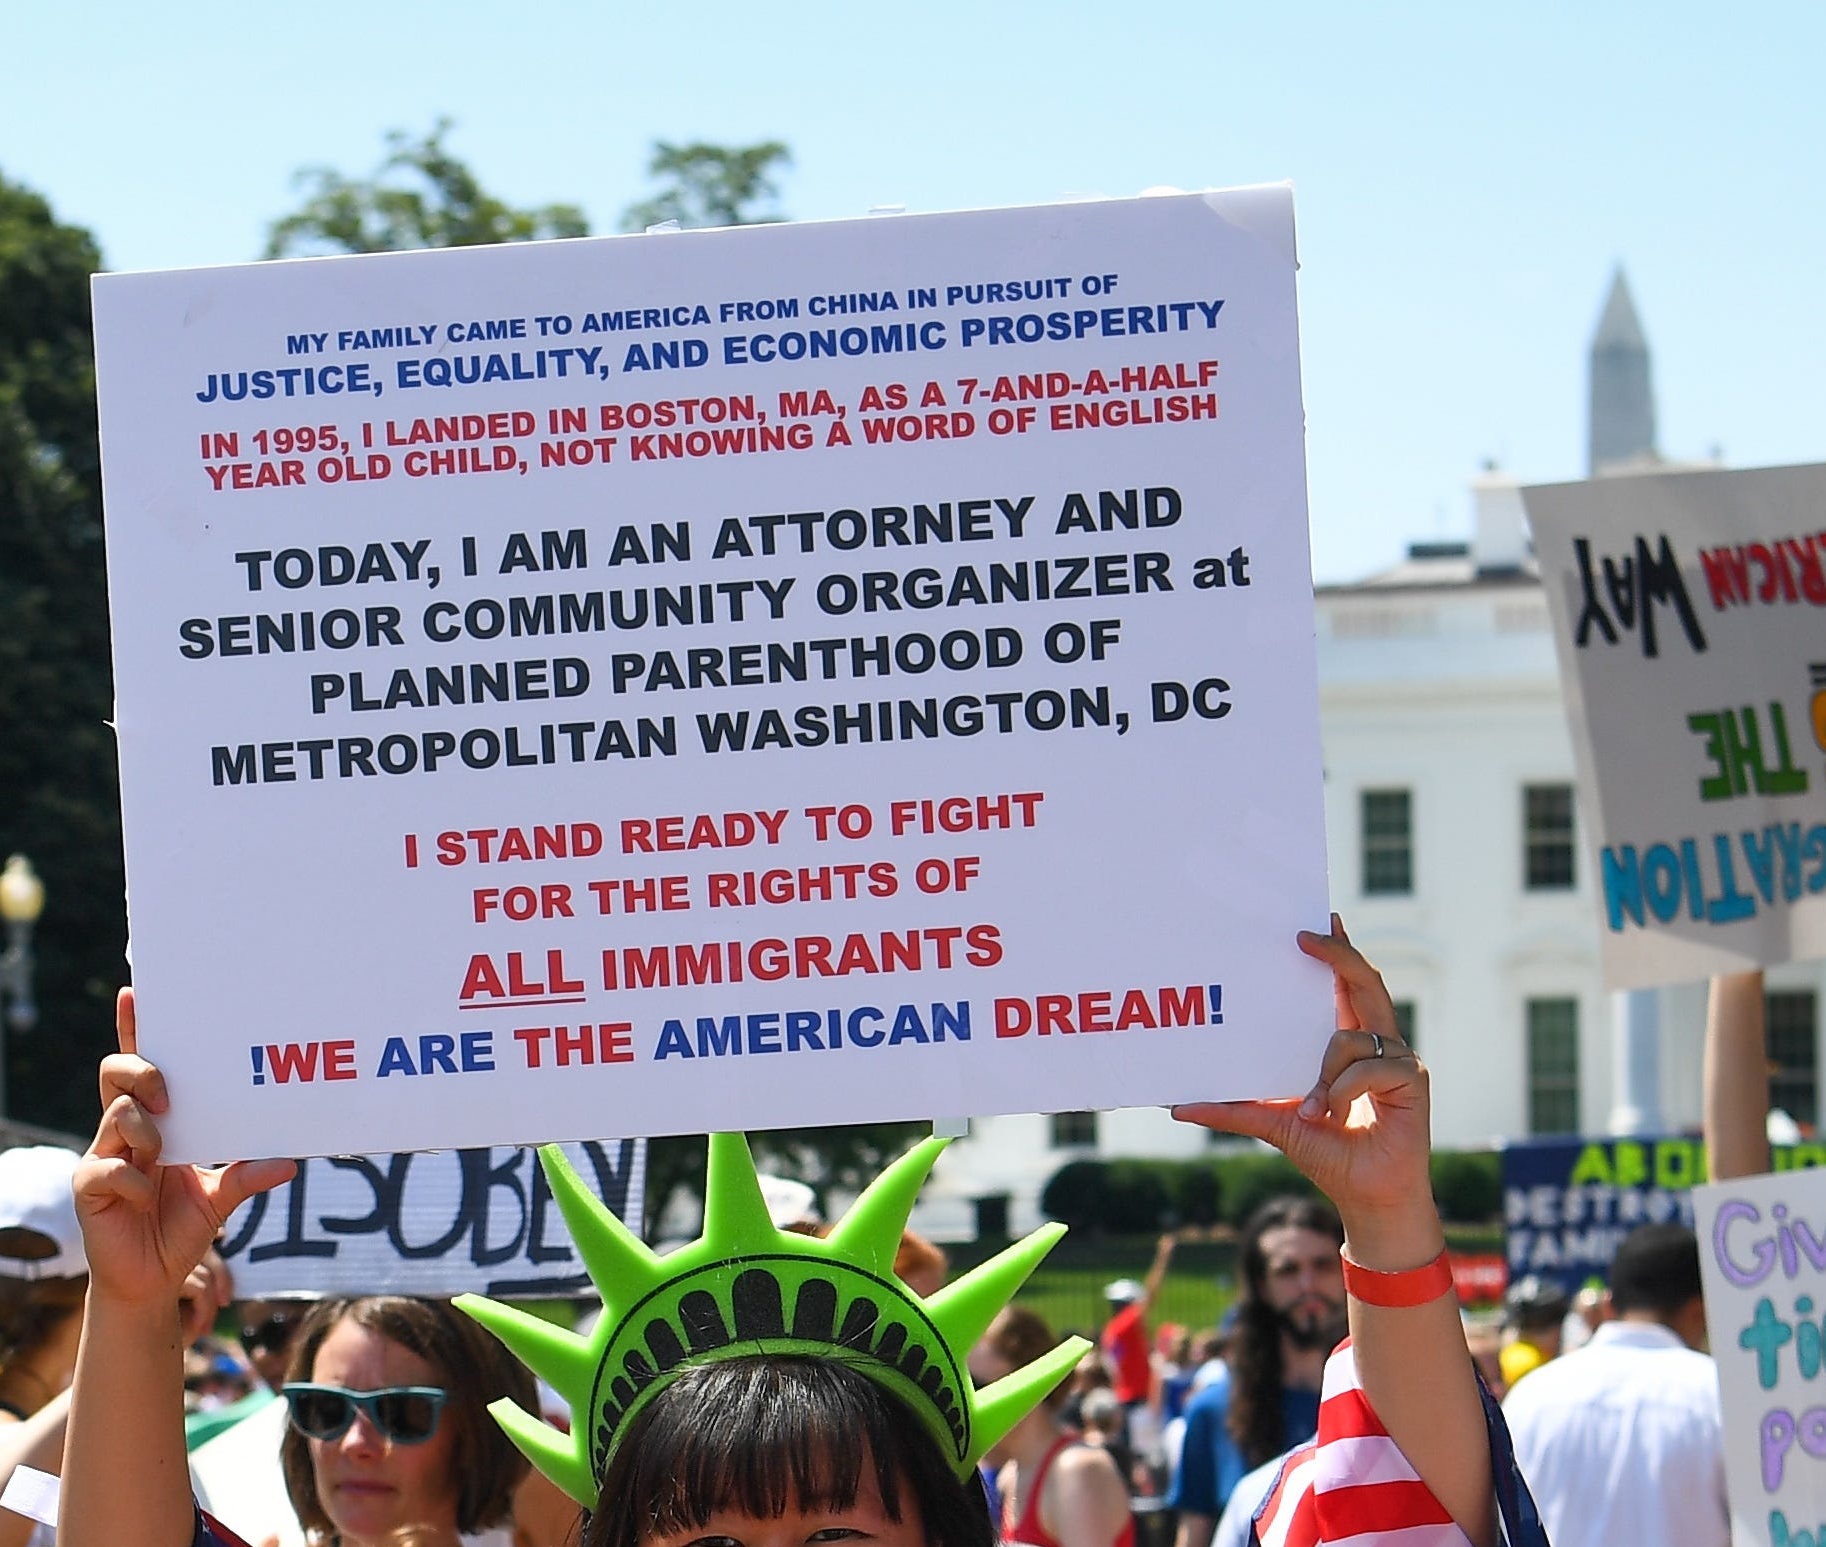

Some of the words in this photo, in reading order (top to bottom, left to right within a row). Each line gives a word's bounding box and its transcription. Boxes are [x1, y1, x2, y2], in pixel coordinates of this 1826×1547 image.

[195, 363, 383, 404] JUSTICE,
[396, 345, 609, 389] EQUALITY,
[622, 339, 709, 373] AND
[722, 320, 947, 365] ECONOMIC
[960, 299, 1226, 348] PROSPERITY
[286, 332, 329, 356] MY
[337, 324, 438, 352] FAMILY
[446, 318, 527, 343] CAME
[534, 315, 573, 337] TO
[581, 304, 712, 334] AMERICA
[719, 297, 799, 324] FROM
[807, 290, 900, 317] CHINA
[907, 287, 938, 310] IN
[946, 277, 1073, 307] PURSUIT
[1081, 273, 1119, 296] OF
[200, 431, 239, 460] IN
[252, 424, 350, 456] 1995,
[362, 422, 373, 449] I
[385, 411, 536, 447] LANDED
[548, 406, 587, 435] IN
[600, 394, 767, 432] BOSTON,
[778, 389, 847, 421] MA,
[858, 383, 908, 413] AS
[919, 381, 947, 408] A
[956, 360, 1219, 405] 7-AND-A-HALF
[204, 459, 307, 491] YEAR
[317, 453, 392, 484] OLD
[403, 445, 528, 478] CHILD,
[540, 437, 618, 468] NOT
[630, 423, 814, 462] KNOWING
[825, 420, 853, 448] A
[861, 411, 976, 445] WORD
[987, 406, 1037, 436] OF
[1049, 393, 1218, 431] ENGLISH
[234, 539, 441, 592] TODAY,
[461, 536, 478, 577] I
[498, 528, 588, 575] AM
[607, 521, 691, 567] AN
[711, 496, 1036, 560] ATTORNEY
[1054, 486, 1182, 536] AND
[179, 606, 405, 660] SENIOR
[422, 577, 797, 643] COMMUNITY
[816, 551, 1175, 616] ORGANIZER
[1192, 545, 1251, 590] at
[1573, 532, 1709, 658] WAY
[310, 657, 591, 715] PLANNED
[611, 627, 1023, 695] PARENTHOOD
[1043, 618, 1121, 664] OF
[210, 715, 677, 787] METROPOLITAN
[695, 685, 1130, 754] WASHINGTON,
[1150, 677, 1233, 723] DC
[1686, 700, 1808, 801] THE
[404, 833, 418, 869] I
[436, 822, 603, 867] STAND
[620, 809, 790, 855] READY
[804, 804, 873, 842] TO
[890, 791, 1044, 837] FIGHT
[473, 883, 575, 924] FOR
[587, 875, 691, 915] THE
[707, 862, 899, 908] RIGHTS
[915, 856, 980, 894] OF
[458, 949, 587, 1011] ALL
[602, 924, 1003, 991] IMMIGRANTS
[250, 1039, 358, 1086] !WE
[376, 1030, 496, 1078] ARE
[513, 1022, 635, 1069] THE
[653, 1000, 972, 1061] AMERICAN
[993, 984, 1224, 1039] DREAM!
